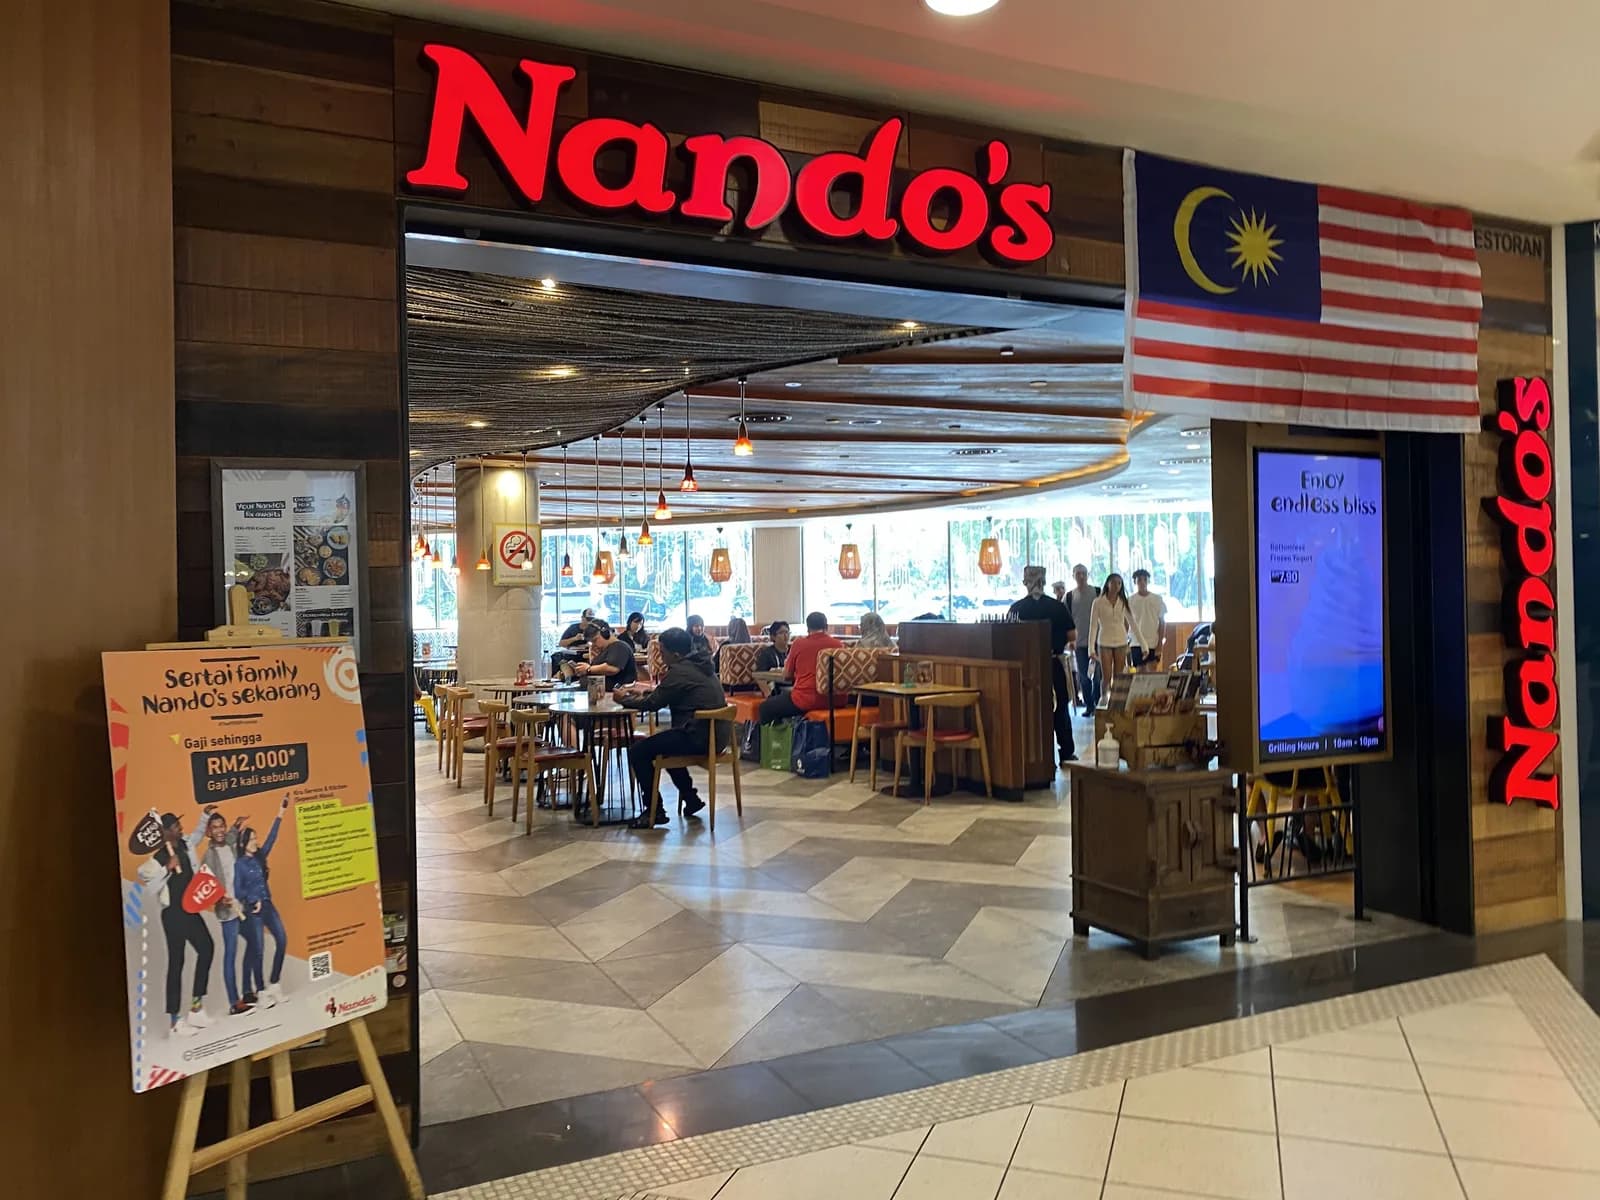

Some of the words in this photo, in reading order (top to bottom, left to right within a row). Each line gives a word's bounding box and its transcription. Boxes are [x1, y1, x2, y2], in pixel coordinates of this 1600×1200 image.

[406, 43, 1054, 262] Nando's
[1270, 493, 1340, 514] endless
[1343, 494, 1377, 516] bliss
[1498, 376, 1560, 810] Nando's
[165, 664, 232, 689] Sertai
[237, 660, 298, 682] family
[142, 688, 227, 715] Nando's
[231, 682, 321, 705] sekarang
[184, 737, 207, 749] Gaji
[211, 734, 262, 746] sehingga
[1297, 741, 1320, 752] Hours
[1333, 738, 1353, 748] 10am
[1360, 736, 1379, 747] 10pm
[207, 780, 228, 791] Gaji
[231, 777, 238, 788] 2
[240, 775, 259, 786] kali
[260, 771, 299, 784] sebulan
[192, 879, 217, 904] HOT
